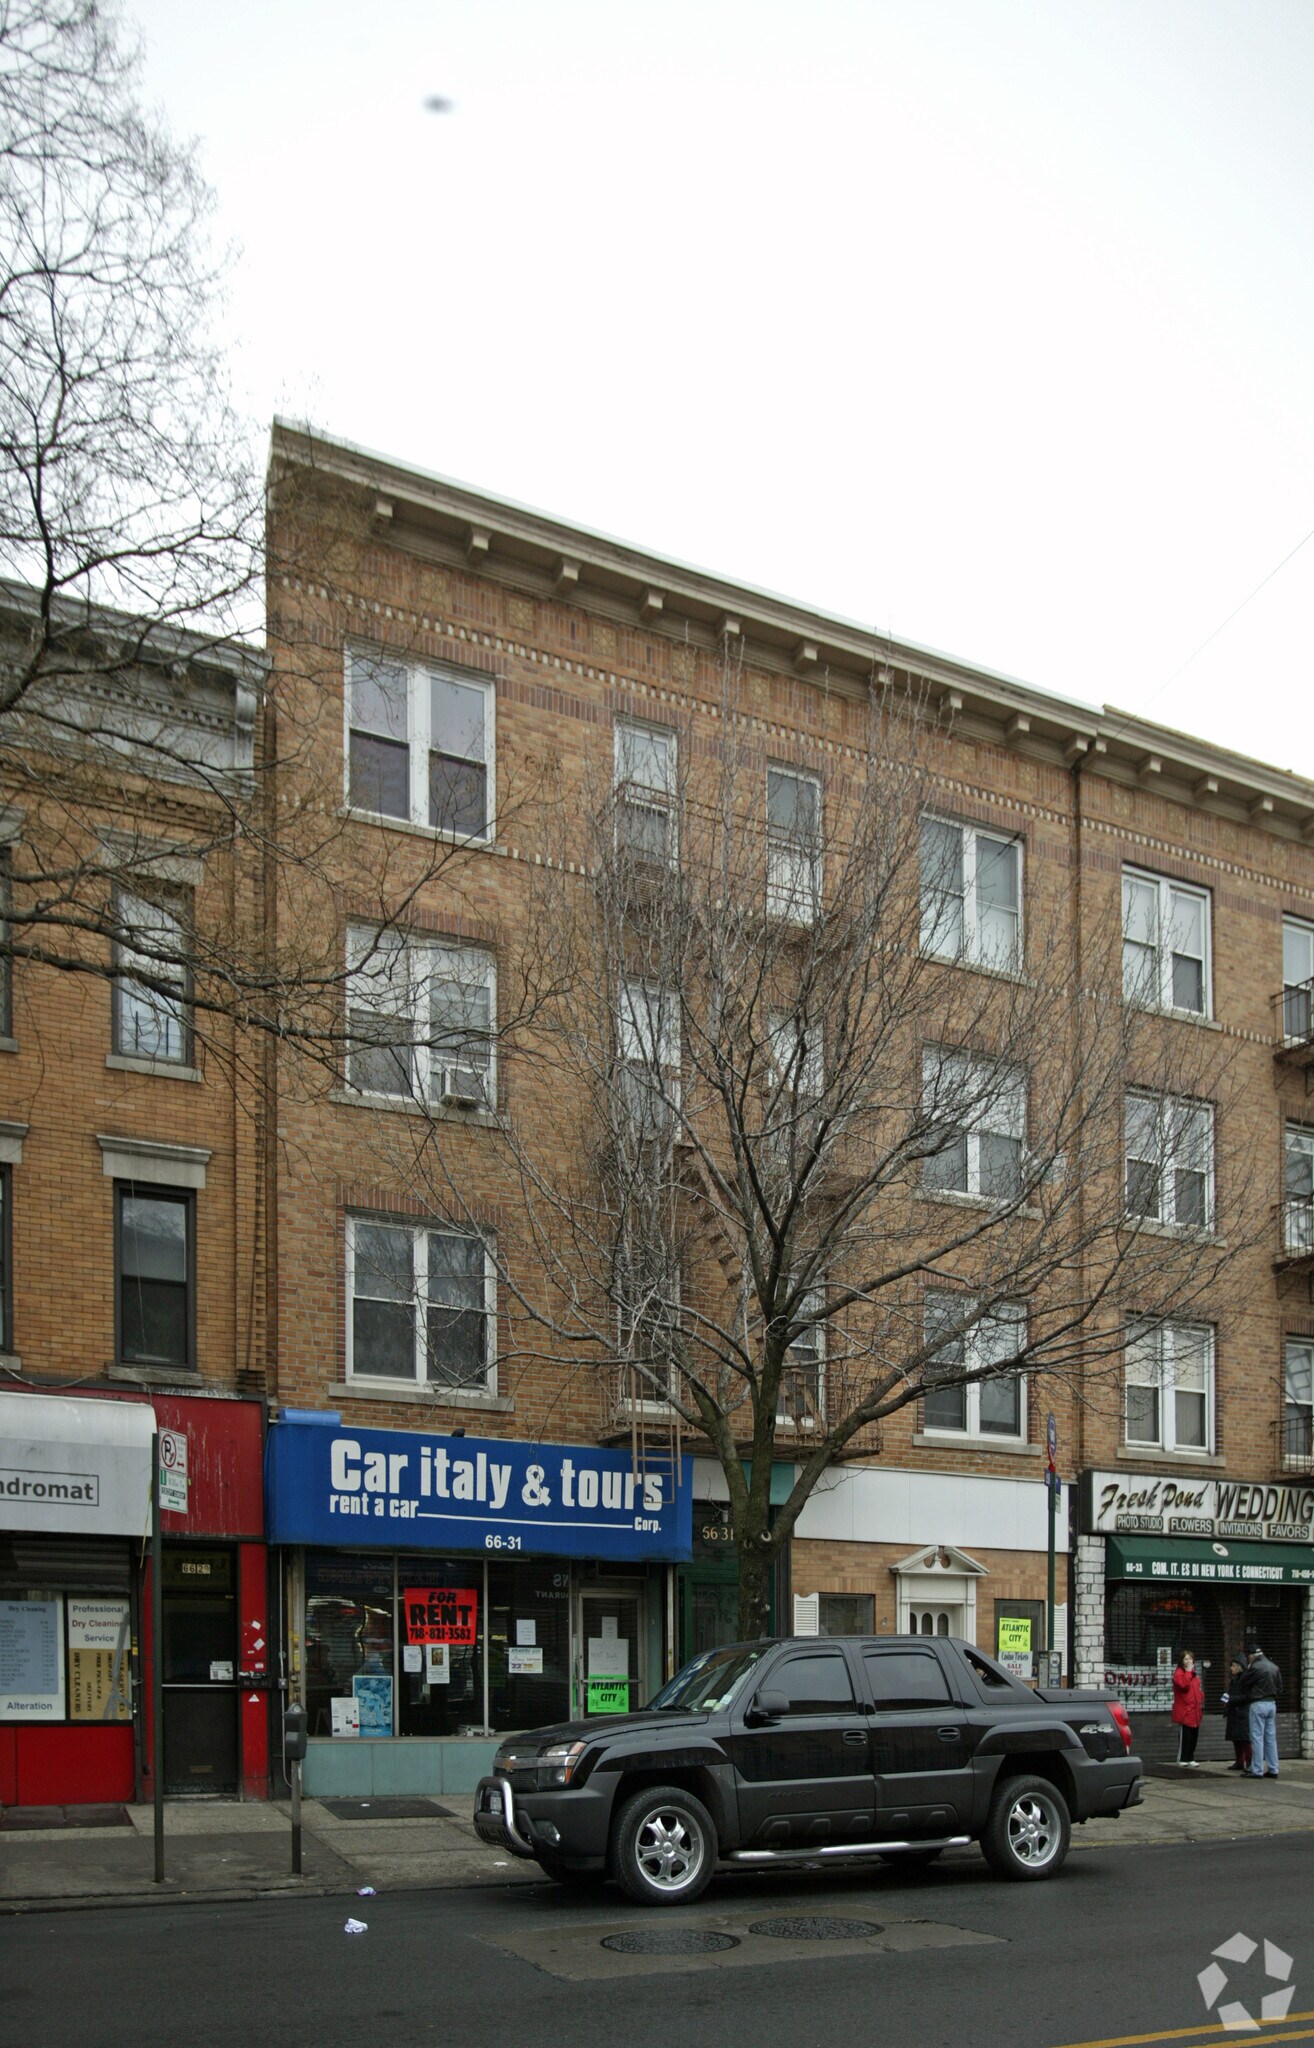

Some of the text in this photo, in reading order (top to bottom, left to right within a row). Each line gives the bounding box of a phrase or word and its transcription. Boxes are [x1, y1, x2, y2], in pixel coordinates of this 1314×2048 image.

[331, 1439, 663, 1512] Car italy & tours
[329, 1493, 419, 1519] rent a car
[1098, 1481, 1314, 1523] Fresh Pond WEDDING
[634, 1516, 662, 1533] Corp.
[1117, 1515, 1308, 1538] PHOTO STUDIO FLOWERS INVITATIONS FAVORS
[485, 1534, 522, 1550] 66-31
[1181, 1563, 1190, 1576] ES
[1201, 1563, 1216, 1577] NEW
[1217, 1564, 1234, 1578] YORK
[1242, 1565, 1284, 1580] CONNECTICUT
[428, 1592, 457, 1603] FOR
[72, 1605, 124, 1613] Professional
[410, 1604, 473, 1626] RENT
[72, 1620, 86, 1629] Dry
[1001, 1623, 1029, 1633] ATLANTIC
[84, 1634, 115, 1642] Service
[1008, 1634, 1022, 1643] CITY
[590, 1682, 627, 1691] ATLANTIC
[600, 1693, 618, 1702] CITY
[6, 1702, 53, 1710] Alteration
